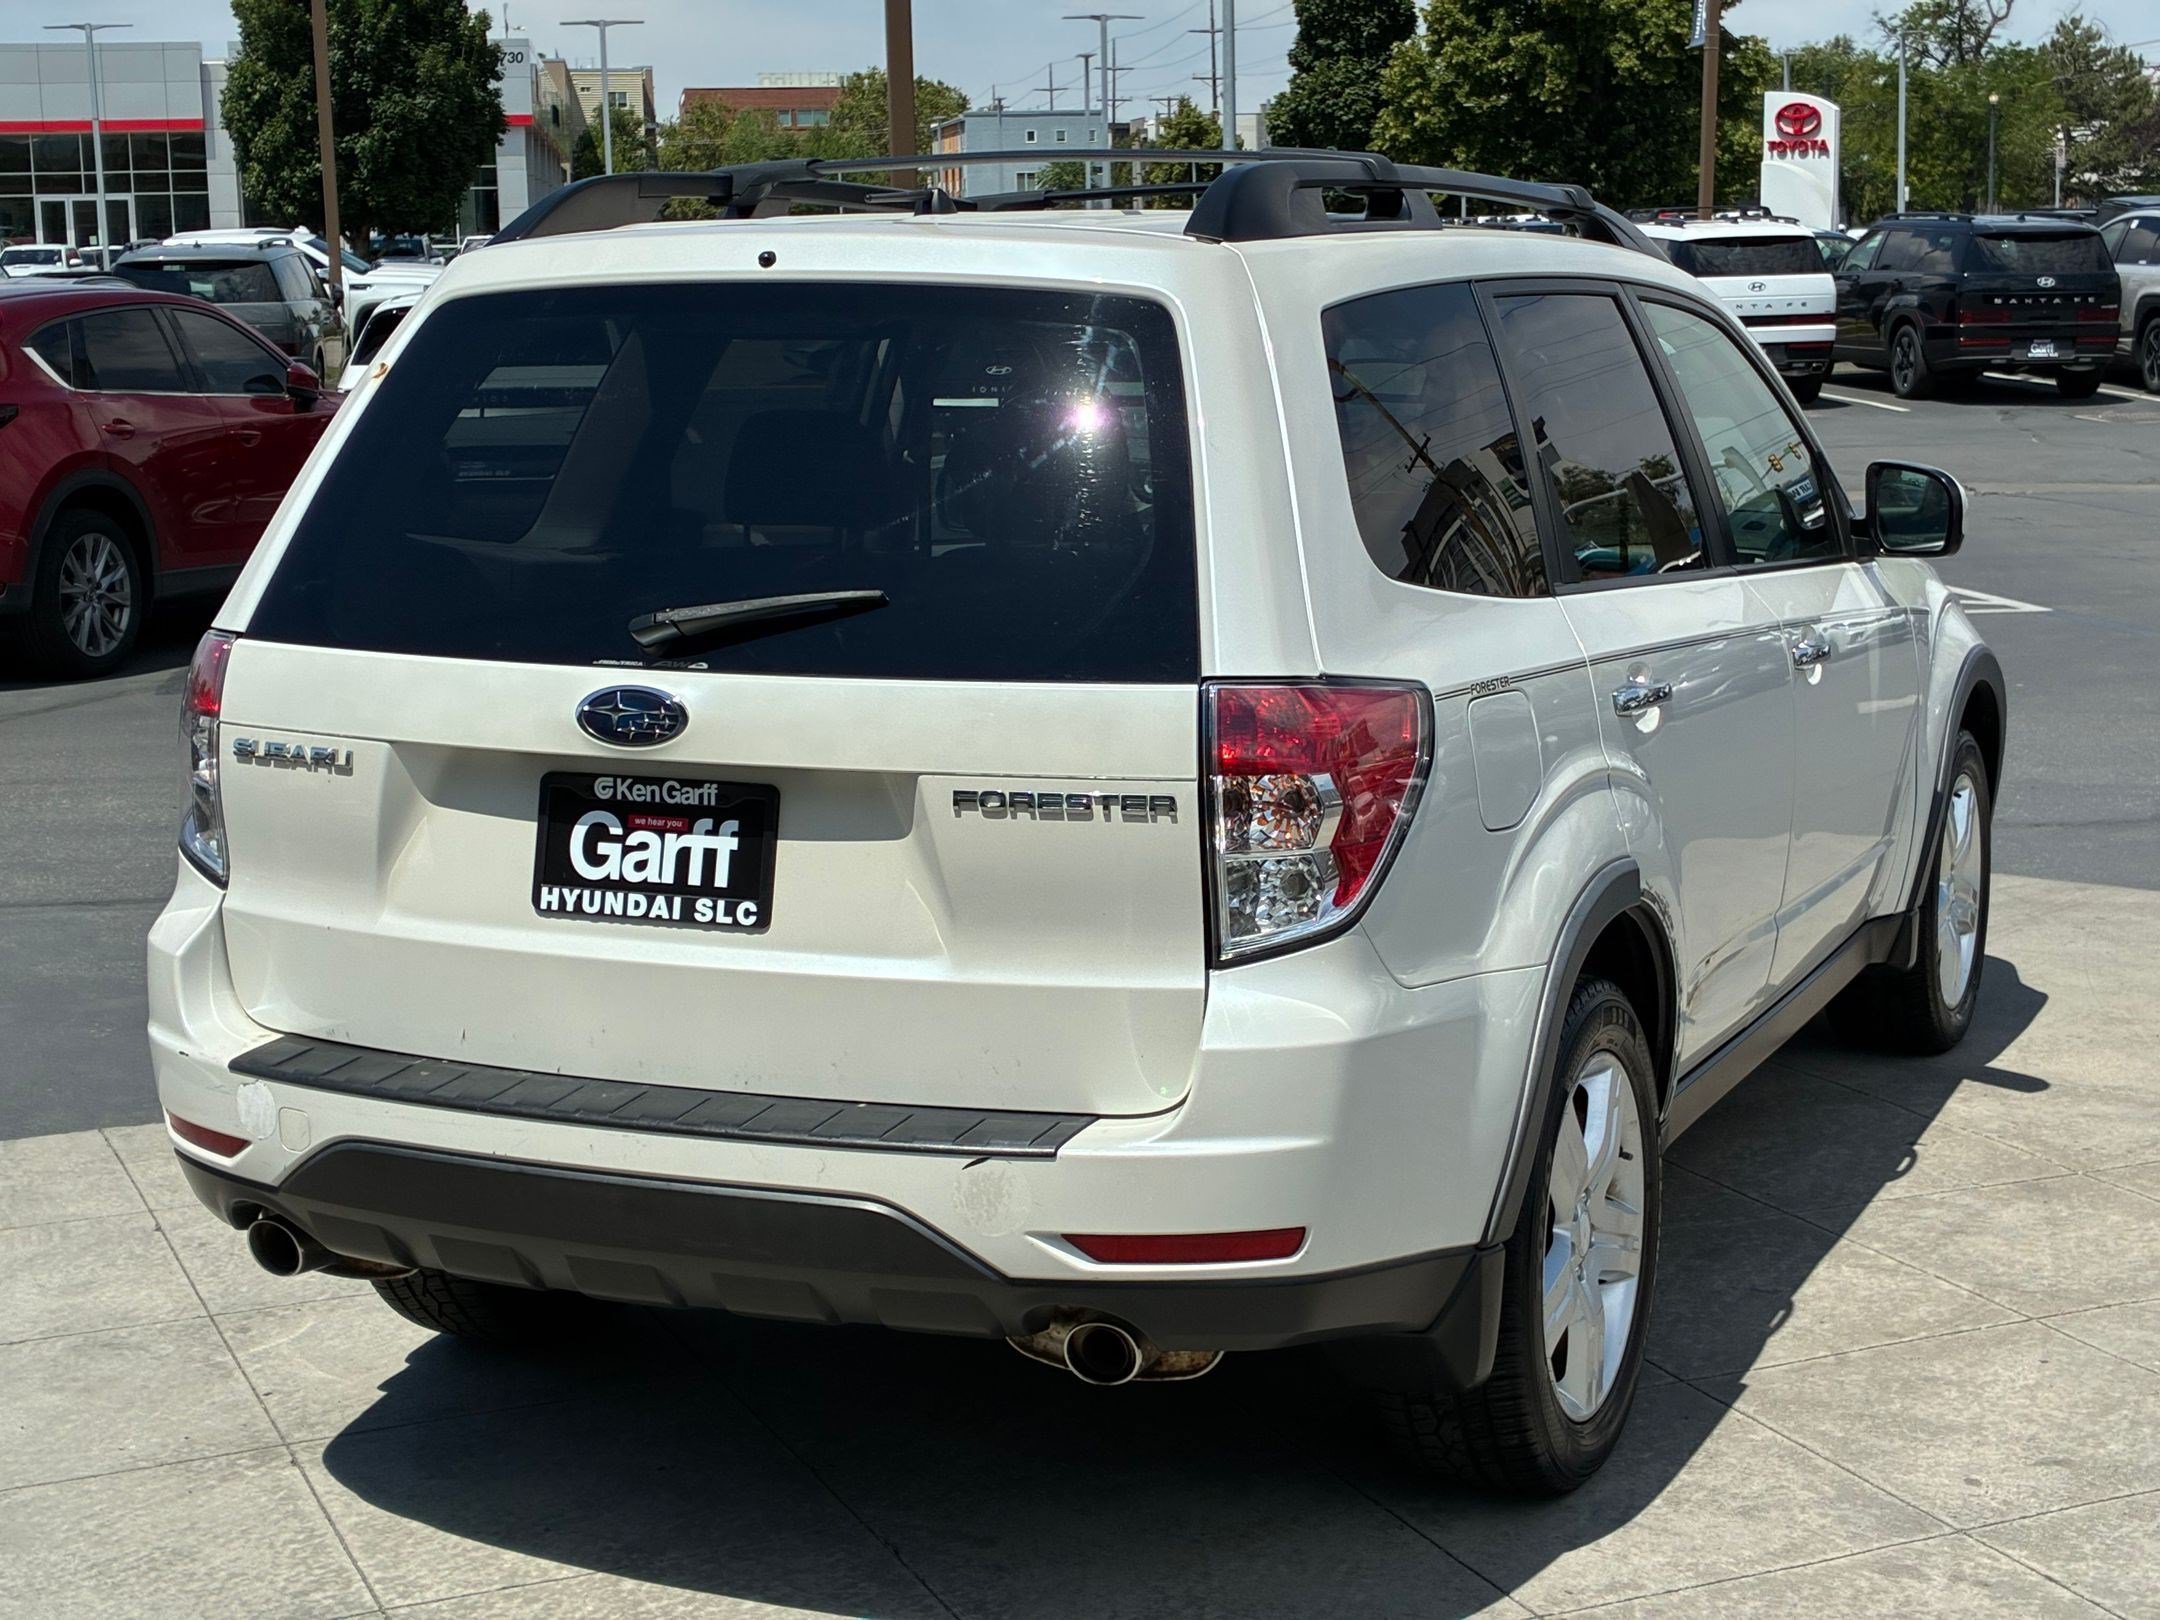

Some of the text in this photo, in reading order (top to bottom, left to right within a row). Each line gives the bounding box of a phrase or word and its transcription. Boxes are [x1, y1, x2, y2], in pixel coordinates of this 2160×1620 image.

[1766, 140, 1829, 154] TOYOTA
[1993, 296, 2096, 305] SANTA FE
[1470, 675, 1511, 696] FORESTER
[232, 737, 354, 769] SUBARU
[616, 777, 719, 807] Ken Garff
[952, 789, 1179, 819] FORESTER
[634, 816, 683, 829] we hear you
[569, 809, 740, 889] Garff
[539, 886, 758, 927] HYUNDAI SLC
